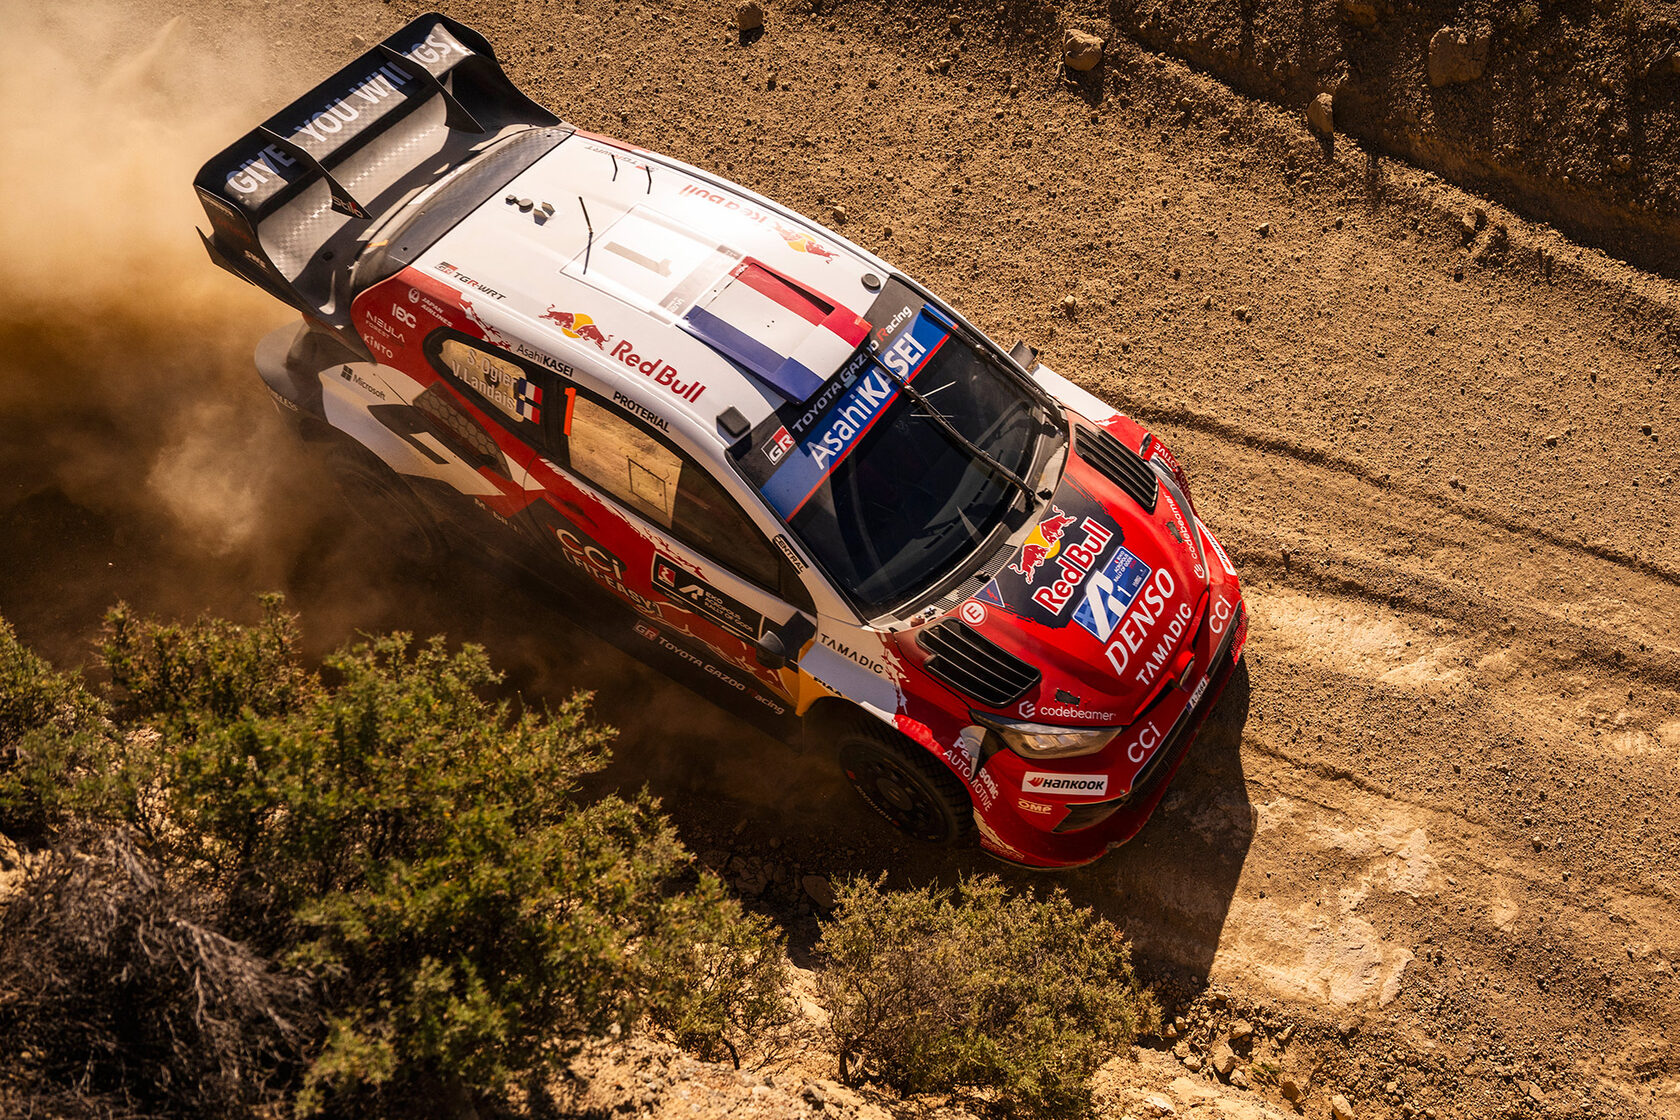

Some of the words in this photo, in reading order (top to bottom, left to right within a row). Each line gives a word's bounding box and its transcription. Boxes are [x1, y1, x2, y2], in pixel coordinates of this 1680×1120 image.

[226, 138, 297, 194] GIVE
[294, 98, 360, 142] YOU
[603, 241, 672, 278] 1
[421, 297, 444, 313] JAPAN
[454, 271, 507, 300] TGR-WRT
[420, 304, 453, 327] AIRLINES
[353, 374, 386, 401] Microsoft
[451, 358, 517, 411] V.Landais
[767, 432, 796, 464] GR
[791, 384, 842, 433] TOYOTA
[876, 306, 913, 342] Racing
[563, 386, 577, 436] 1
[613, 391, 670, 433] PROTERIAL
[1164, 493, 1198, 559] codebeamer
[773, 535, 805, 573] CENTRAL
[1117, 585, 1132, 598] 1
[1104, 567, 1175, 676] DENSO
[634, 621, 660, 641] GR
[659, 636, 704, 667] TOYOTA
[703, 663, 746, 691] GAZOO
[821, 633, 884, 674] TAMADIC
[1135, 602, 1192, 686] TAMADIC
[1040, 706, 1114, 721] codebeamer
[952, 735, 1001, 800] Pasonic
[1018, 799, 1052, 813] OMP
